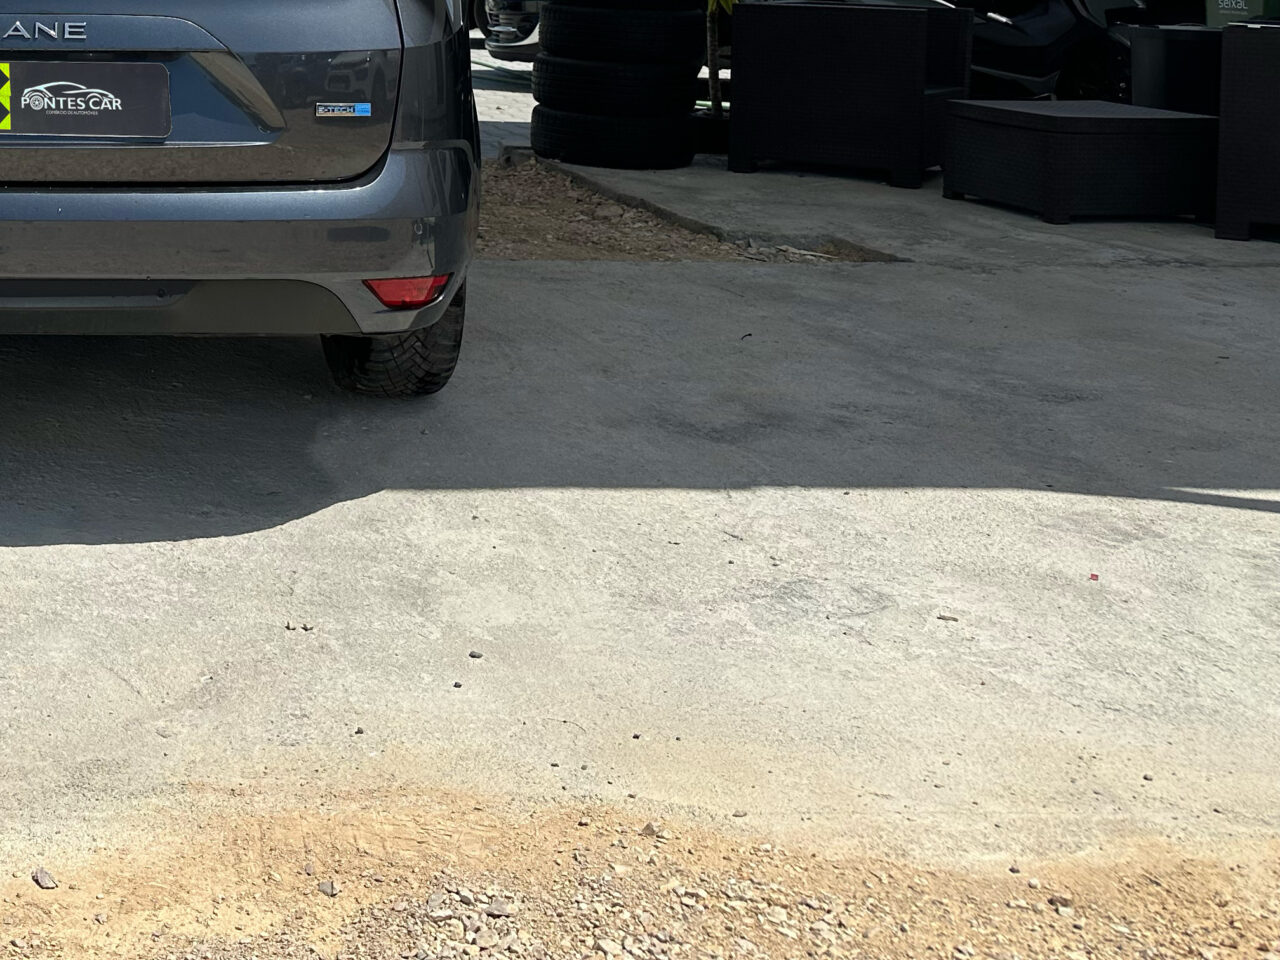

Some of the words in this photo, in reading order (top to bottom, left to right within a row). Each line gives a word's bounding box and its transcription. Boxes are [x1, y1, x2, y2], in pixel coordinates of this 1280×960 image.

[21, 96, 86, 110] PONTES
[89, 97, 122, 110] CAR
[318, 105, 354, 114] E-TECH
